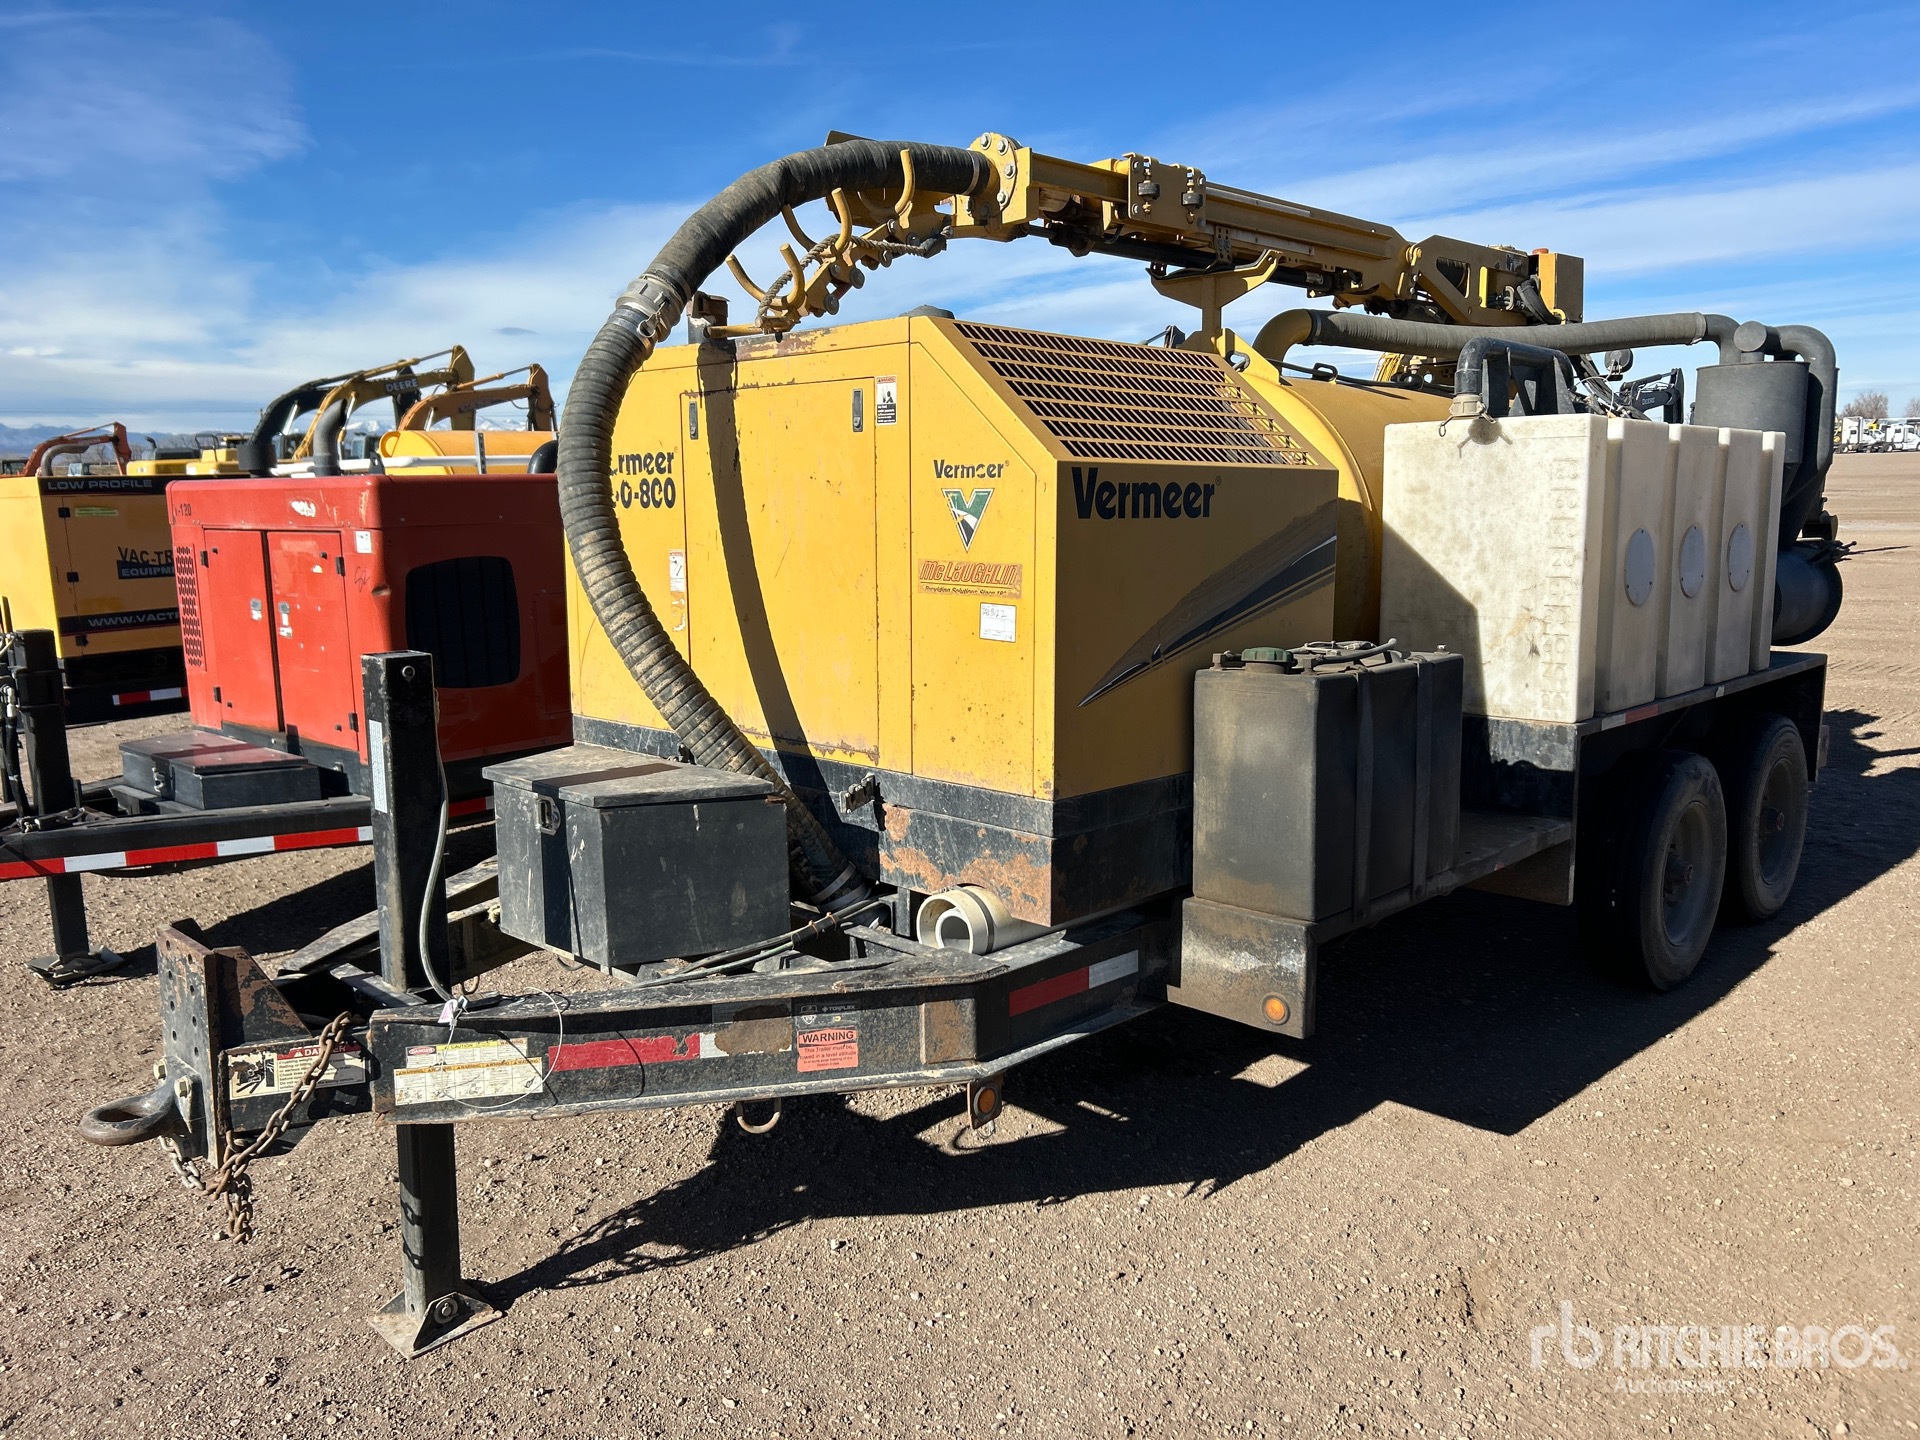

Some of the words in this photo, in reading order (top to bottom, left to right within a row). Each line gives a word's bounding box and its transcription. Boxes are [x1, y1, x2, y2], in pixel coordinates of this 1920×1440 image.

[385, 379, 418, 392] DEERE
[933, 459, 1004, 478] Vermeer
[48, 481, 84, 490] LOW
[88, 479, 152, 489] PROFILE
[1071, 467, 1215, 520] Vermeer
[121, 566, 175, 577] EQUIPM
[803, 1031, 854, 1043] WARNING
[304, 1046, 346, 1056] DAER
